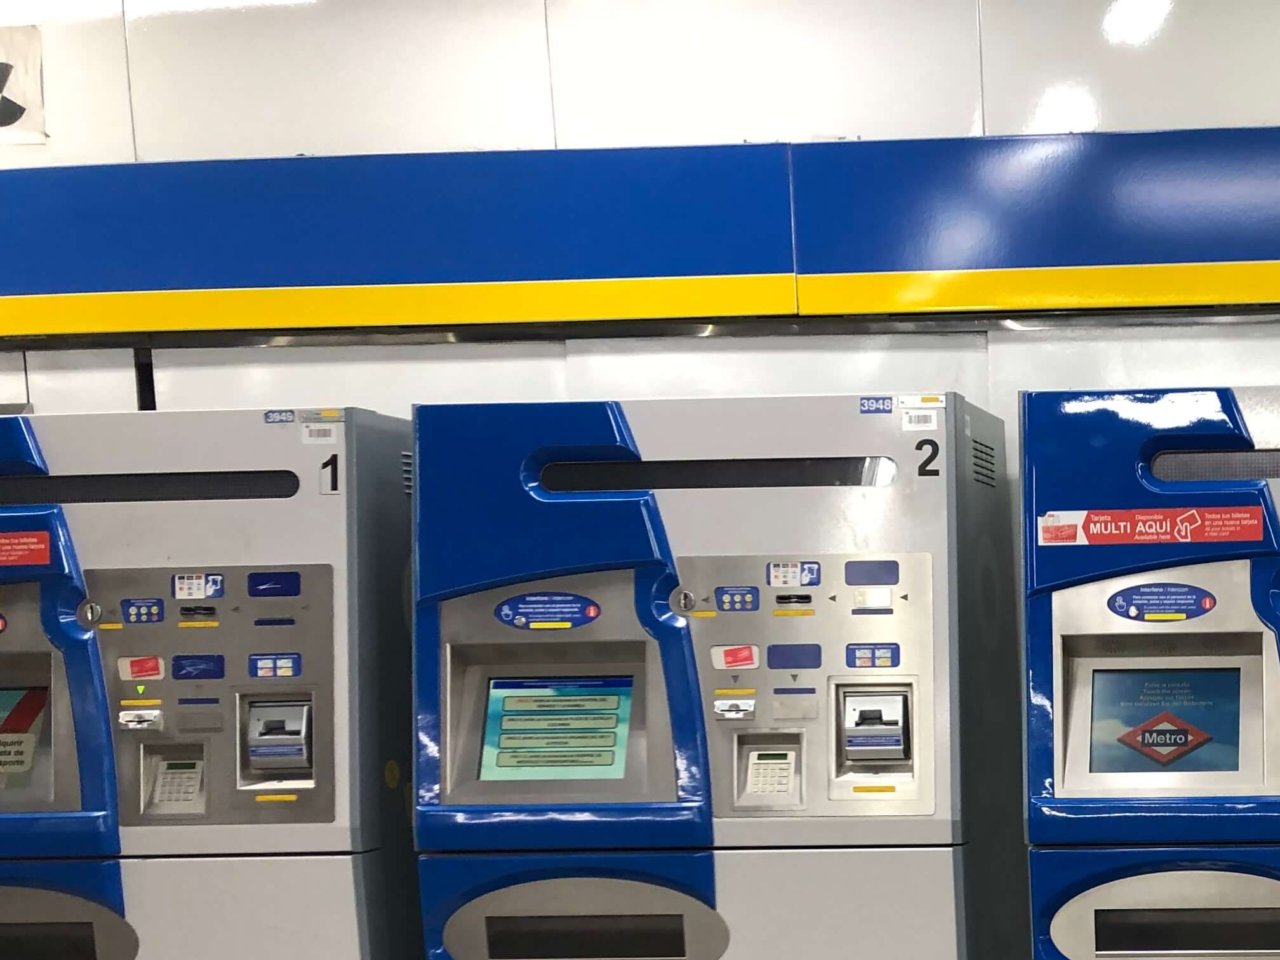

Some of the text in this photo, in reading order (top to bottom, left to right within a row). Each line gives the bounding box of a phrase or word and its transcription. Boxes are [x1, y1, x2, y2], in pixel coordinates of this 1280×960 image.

[861, 399, 892, 410] 3948
[266, 412, 293, 421] 3949
[915, 438, 940, 476] 2
[321, 453, 338, 491] 1
[1089, 518, 1171, 534] MULTI AQUÍ
[1144, 732, 1185, 744] Metro
